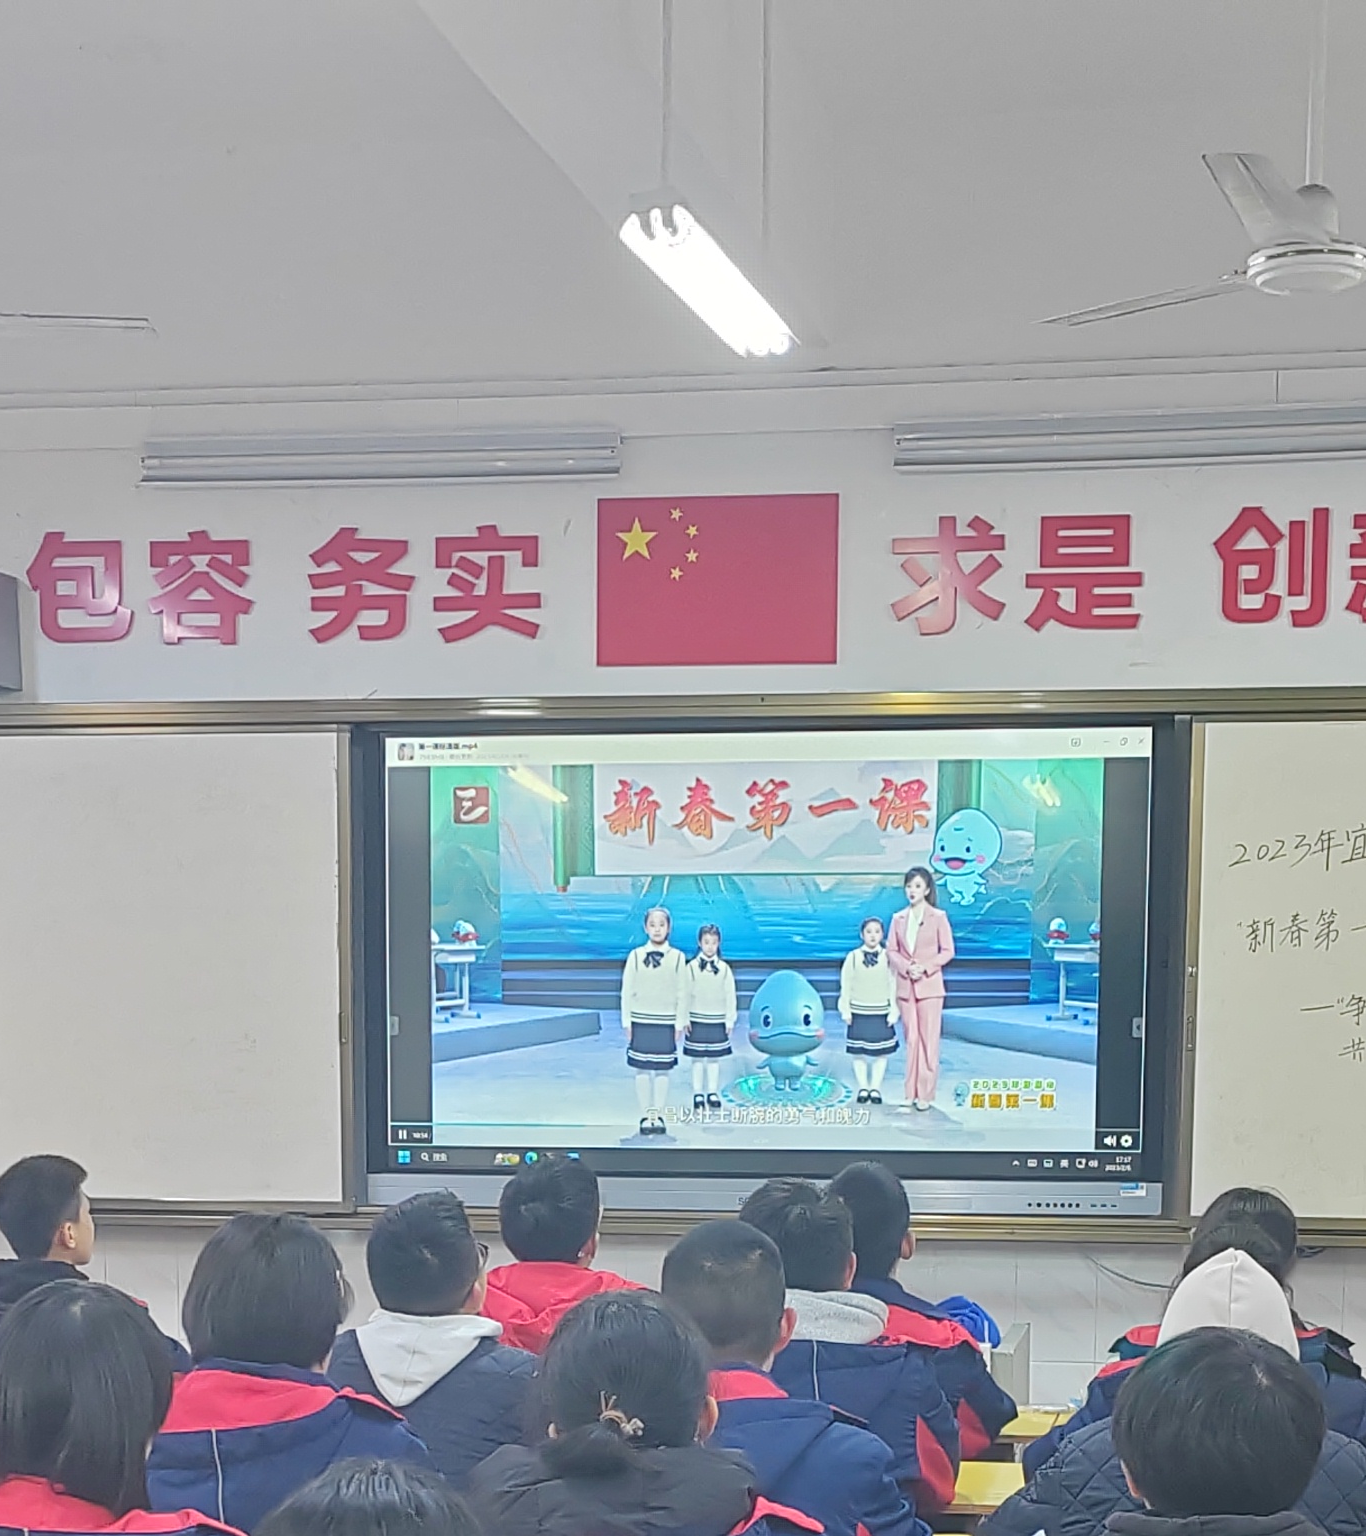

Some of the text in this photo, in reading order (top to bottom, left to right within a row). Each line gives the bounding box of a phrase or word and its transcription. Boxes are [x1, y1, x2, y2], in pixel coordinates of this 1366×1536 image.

[26, 530, 255, 645] 包容
[308, 525, 542, 643] 务实
[891, 514, 1143, 636] 求是
[603, 776, 931, 846] 新春第一课
[645, 1106, 871, 1125] 宜昌以壮士断腕的勇气和魄力
